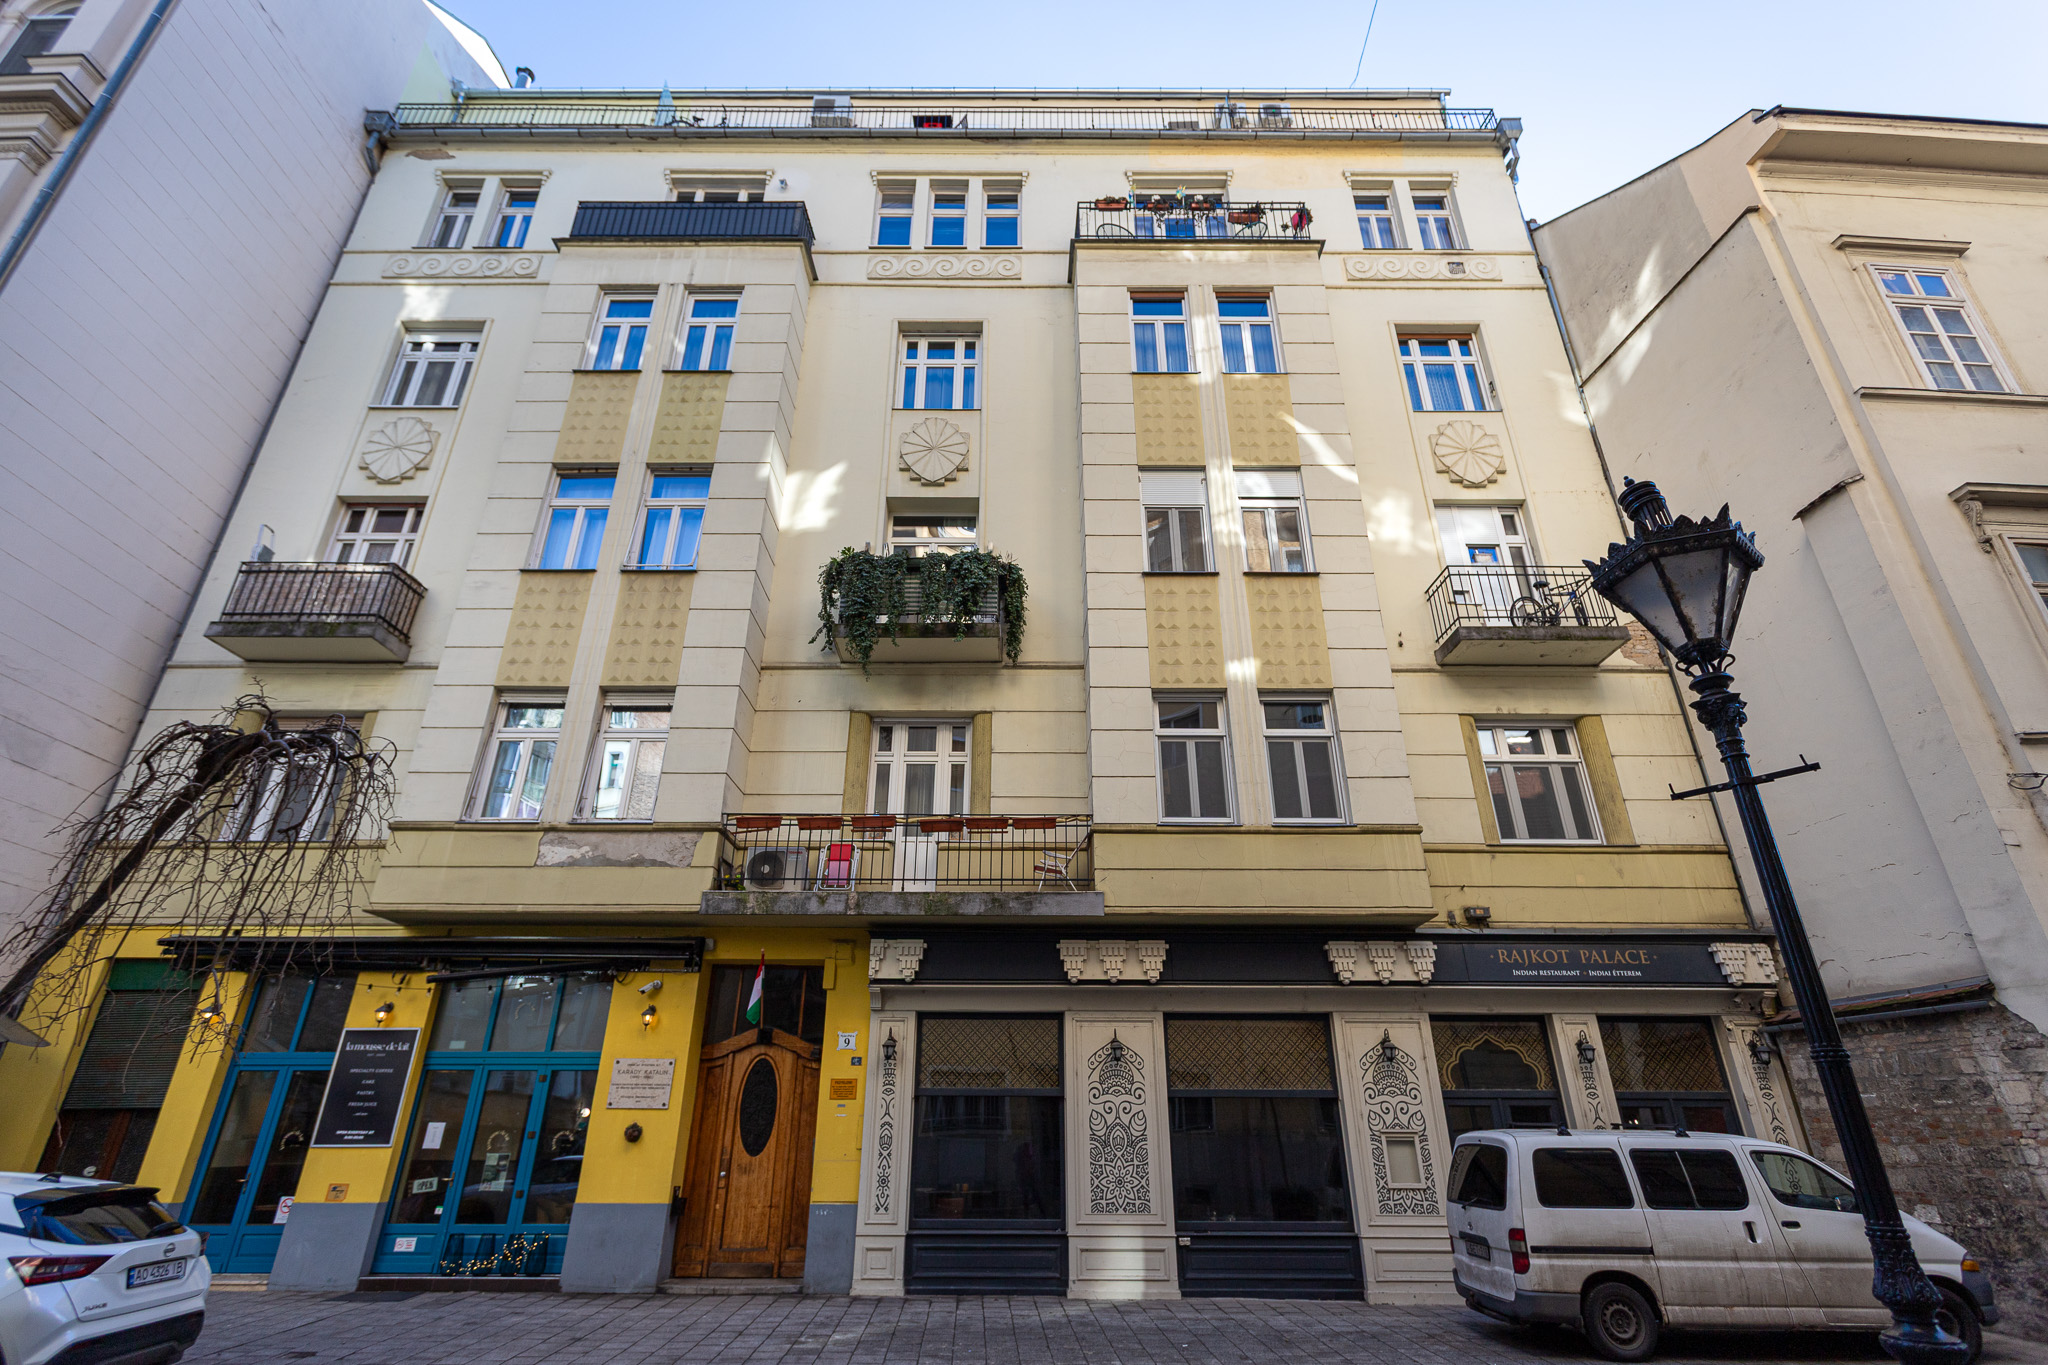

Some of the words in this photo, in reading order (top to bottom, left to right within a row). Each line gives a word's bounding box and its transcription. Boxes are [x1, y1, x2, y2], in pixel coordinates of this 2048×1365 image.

[1496, 949, 1569, 967] RAJKOT
[1579, 949, 1651, 964] PALACE
[844, 1038, 850, 1047] 9
[416, 1180, 434, 1191] OPEN
